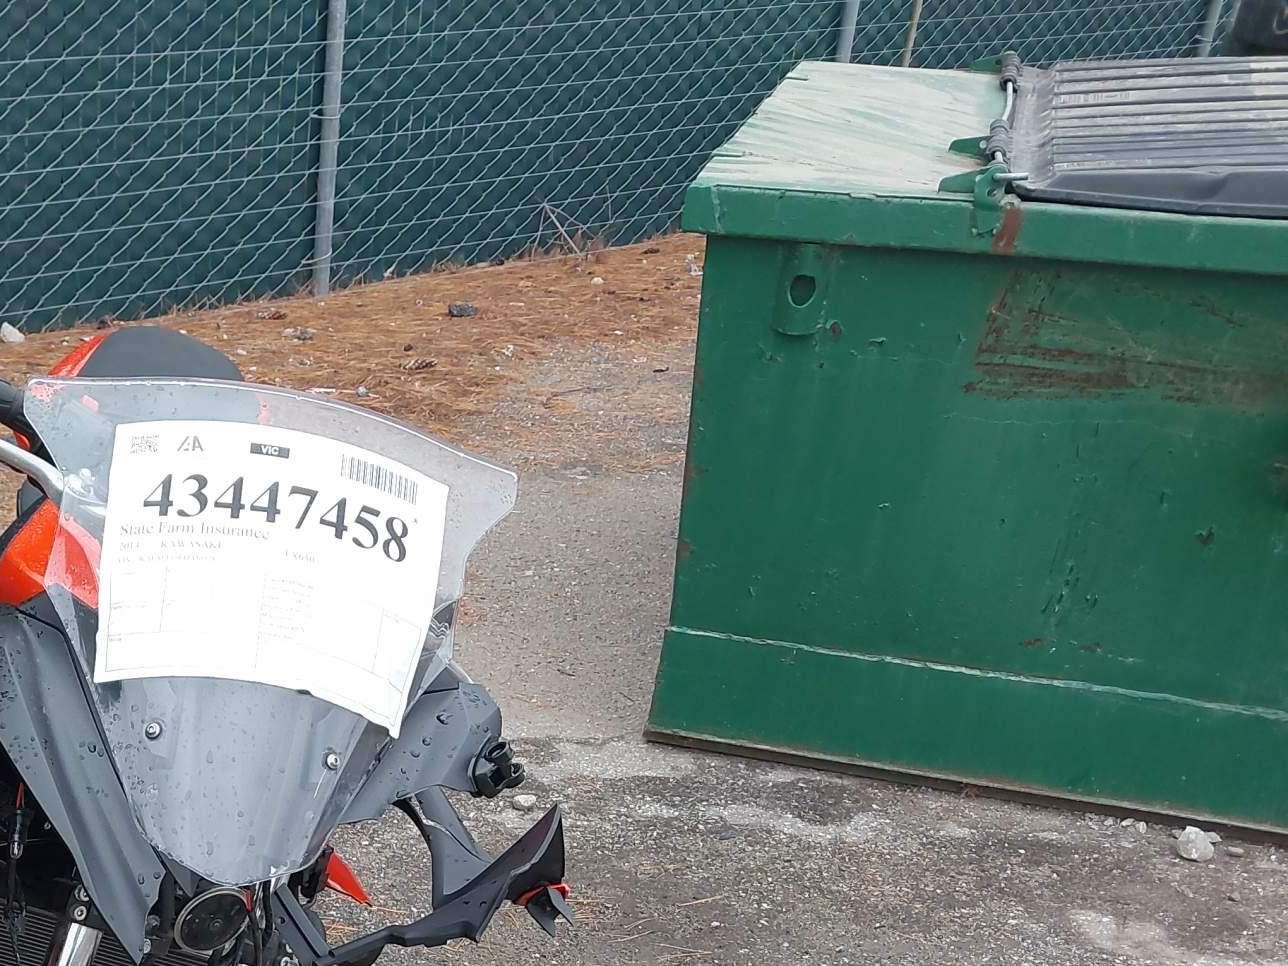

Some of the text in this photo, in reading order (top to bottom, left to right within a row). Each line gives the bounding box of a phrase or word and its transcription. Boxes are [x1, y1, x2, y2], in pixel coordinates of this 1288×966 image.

[119, 521, 271, 541] State Farm Insurance
[143, 473, 409, 563] 43447458
